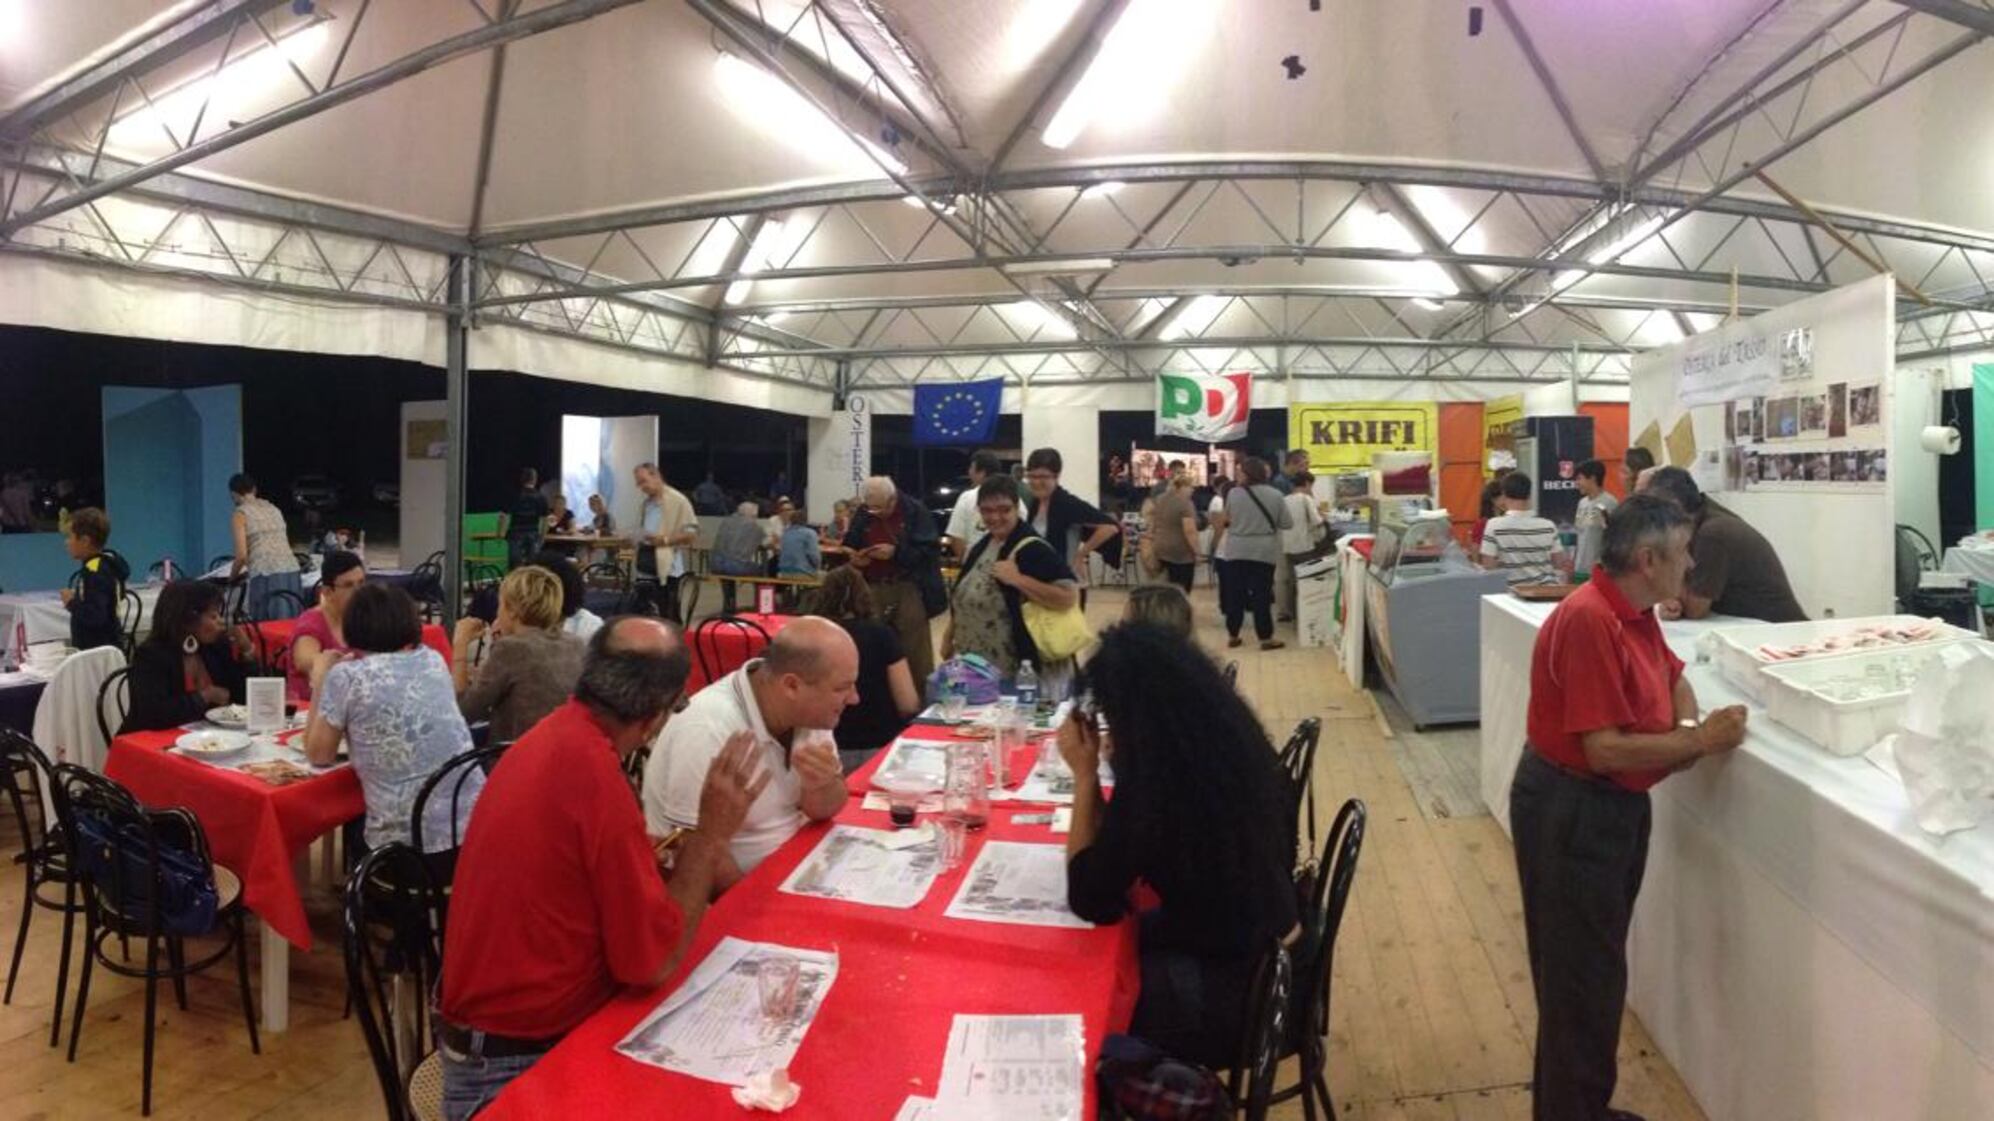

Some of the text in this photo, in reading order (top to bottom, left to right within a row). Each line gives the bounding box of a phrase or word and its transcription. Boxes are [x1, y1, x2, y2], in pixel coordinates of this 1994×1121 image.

[1160, 373, 1249, 423] PD
[850, 396, 865, 497] OSTERI
[1310, 420, 1415, 445] KRIFI
[1543, 480, 1579, 491] BECK
